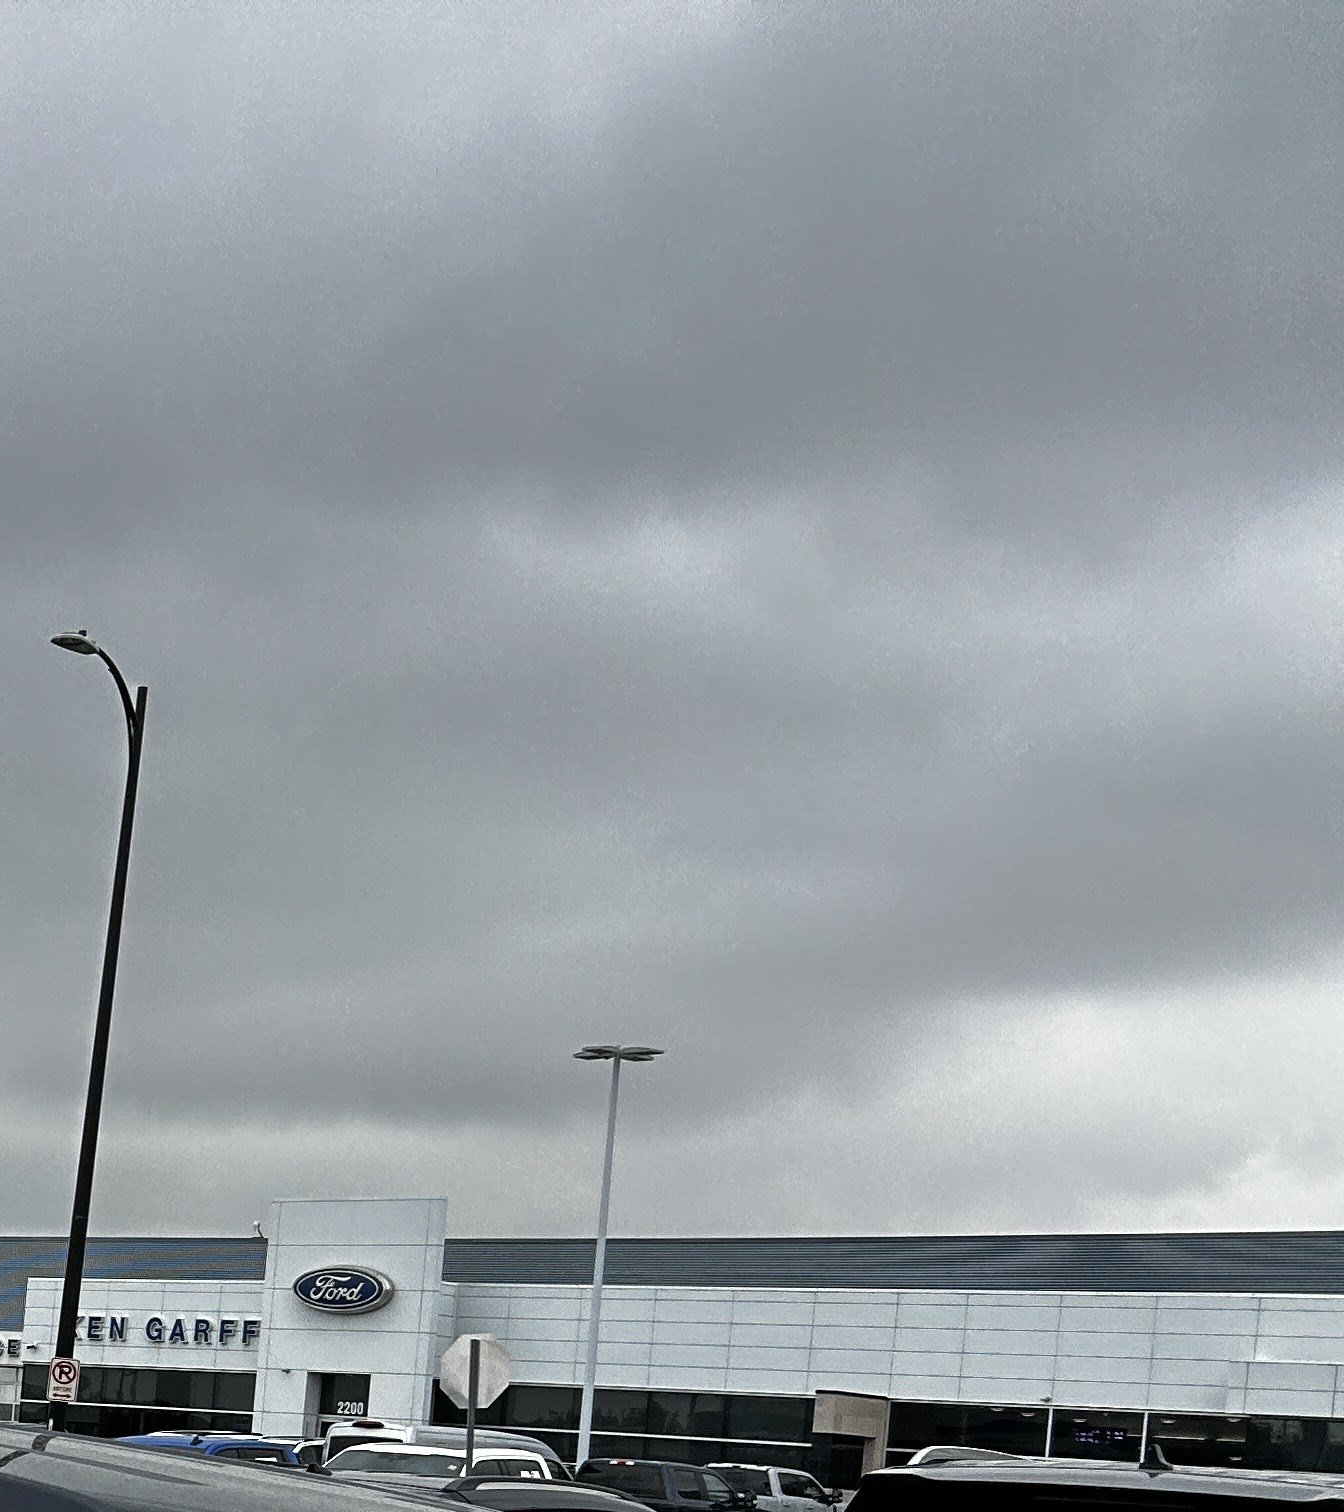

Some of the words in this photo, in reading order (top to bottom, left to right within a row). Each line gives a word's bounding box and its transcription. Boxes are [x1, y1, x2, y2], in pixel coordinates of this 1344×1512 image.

[309, 1274, 365, 1301] Ford
[145, 1316, 263, 1346] GARFF
[336, 1400, 364, 1416] 2200
